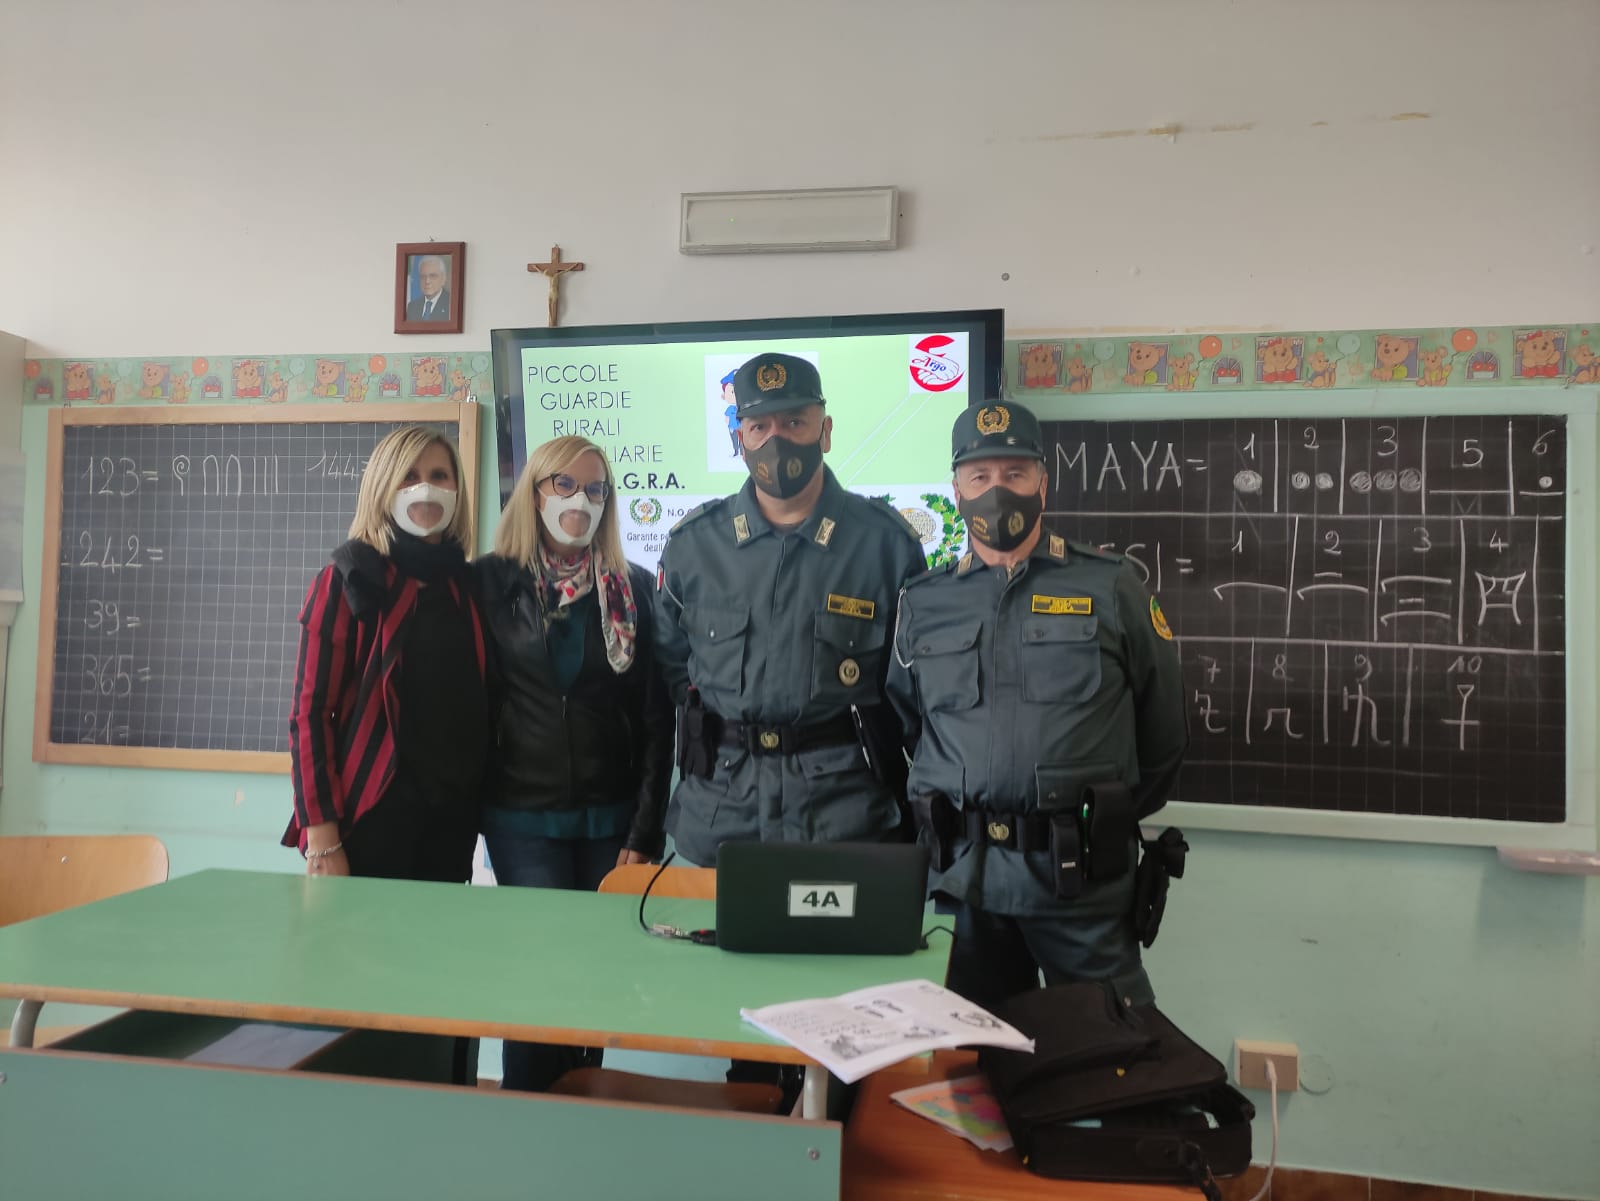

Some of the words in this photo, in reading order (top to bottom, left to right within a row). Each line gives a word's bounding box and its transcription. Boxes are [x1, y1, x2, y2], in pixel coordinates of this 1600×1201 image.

[528, 363, 618, 384] PICCOLE
[540, 390, 632, 411] GUARDIE
[553, 417, 621, 437] RURALI
[1243, 432, 1255, 460] 1
[1304, 426, 1320, 449] 2
[1377, 425, 1399, 456] 3
[1463, 439, 1484, 468] 5
[1532, 429, 1556, 456] 6
[626, 532, 658, 541] Garante
[1232, 530, 1244, 554] 1
[1323, 530, 1342, 554] 2
[1413, 527, 1432, 551] 3
[1489, 529, 1509, 553] 4
[1199, 655, 1221, 683] 7
[1272, 654, 1294, 681] 8
[1354, 654, 1373, 682] 9
[1448, 656, 1483, 673] 10
[802, 890, 841, 908] 4A
